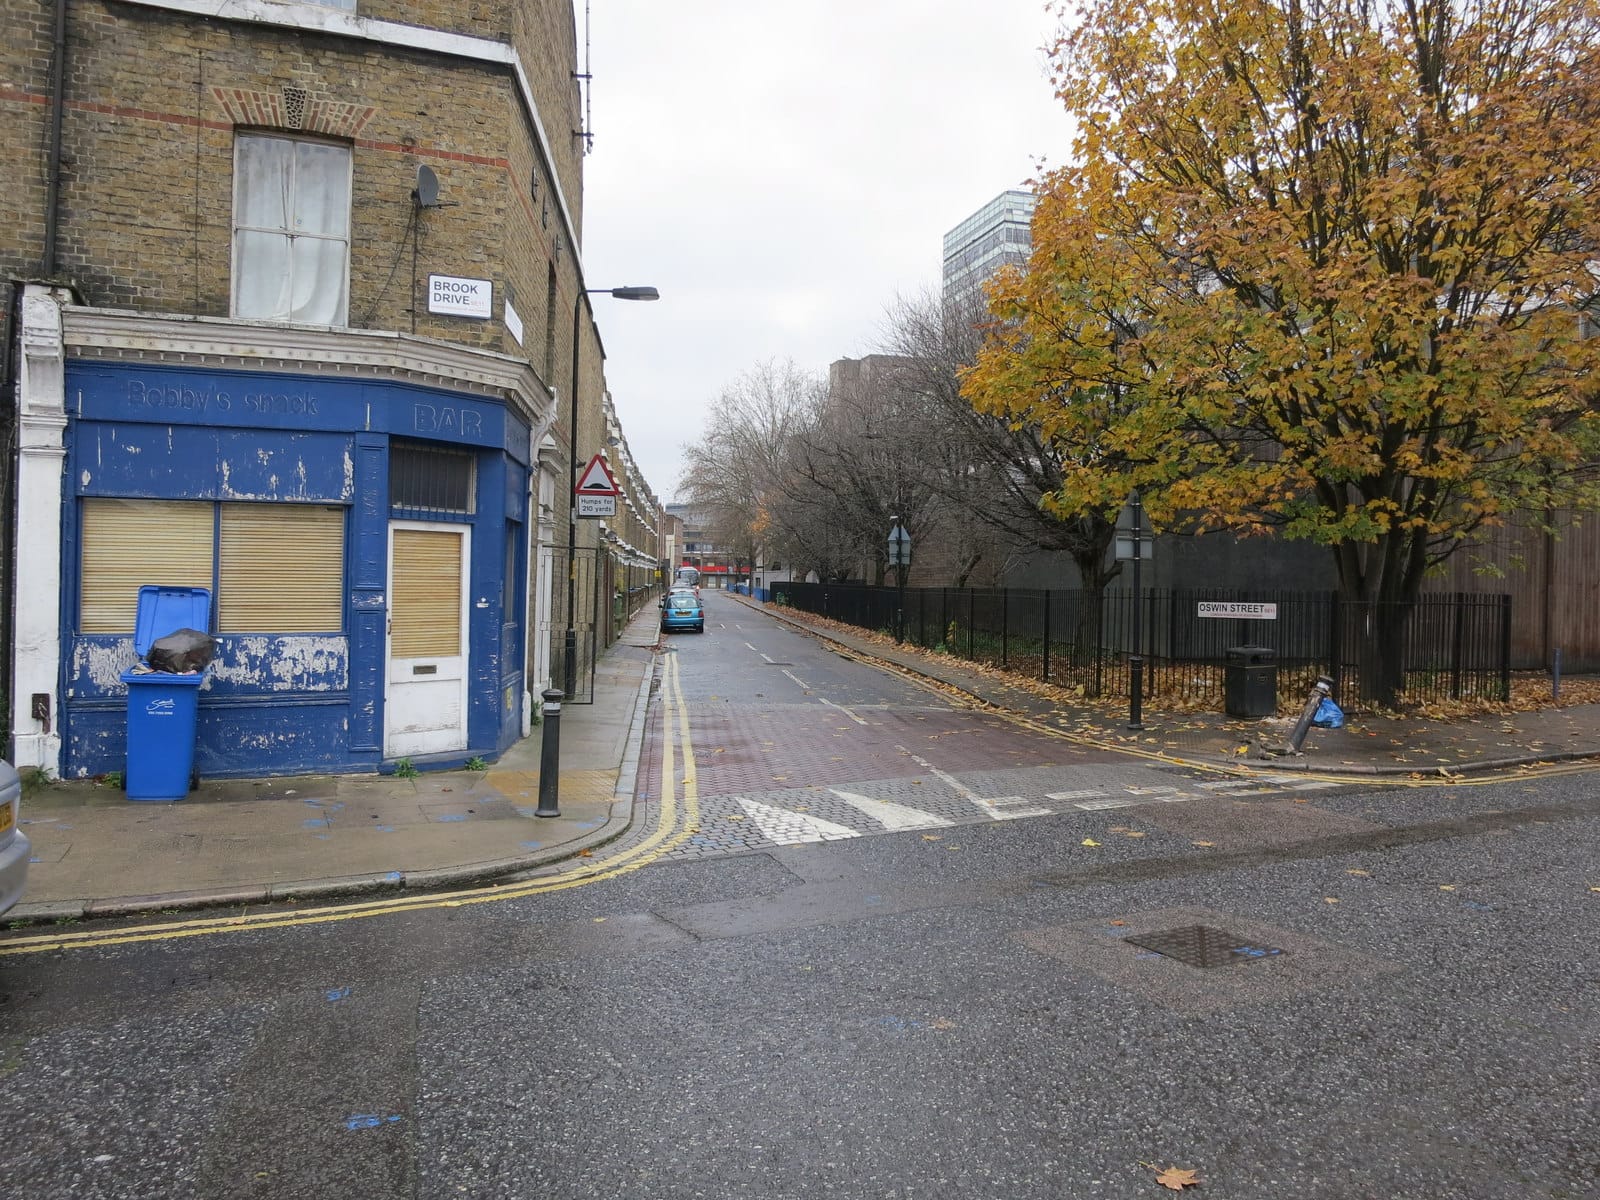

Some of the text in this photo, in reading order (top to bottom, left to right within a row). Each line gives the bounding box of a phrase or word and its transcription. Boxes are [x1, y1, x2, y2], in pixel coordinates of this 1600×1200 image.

[434, 281, 478, 294] BROOK
[434, 293, 470, 305] DRIVE
[127, 378, 319, 415] Bobby's snack
[414, 403, 482, 438] BAR
[1199, 603, 1228, 612] OSWIN
[1230, 604, 1265, 613] STREET
